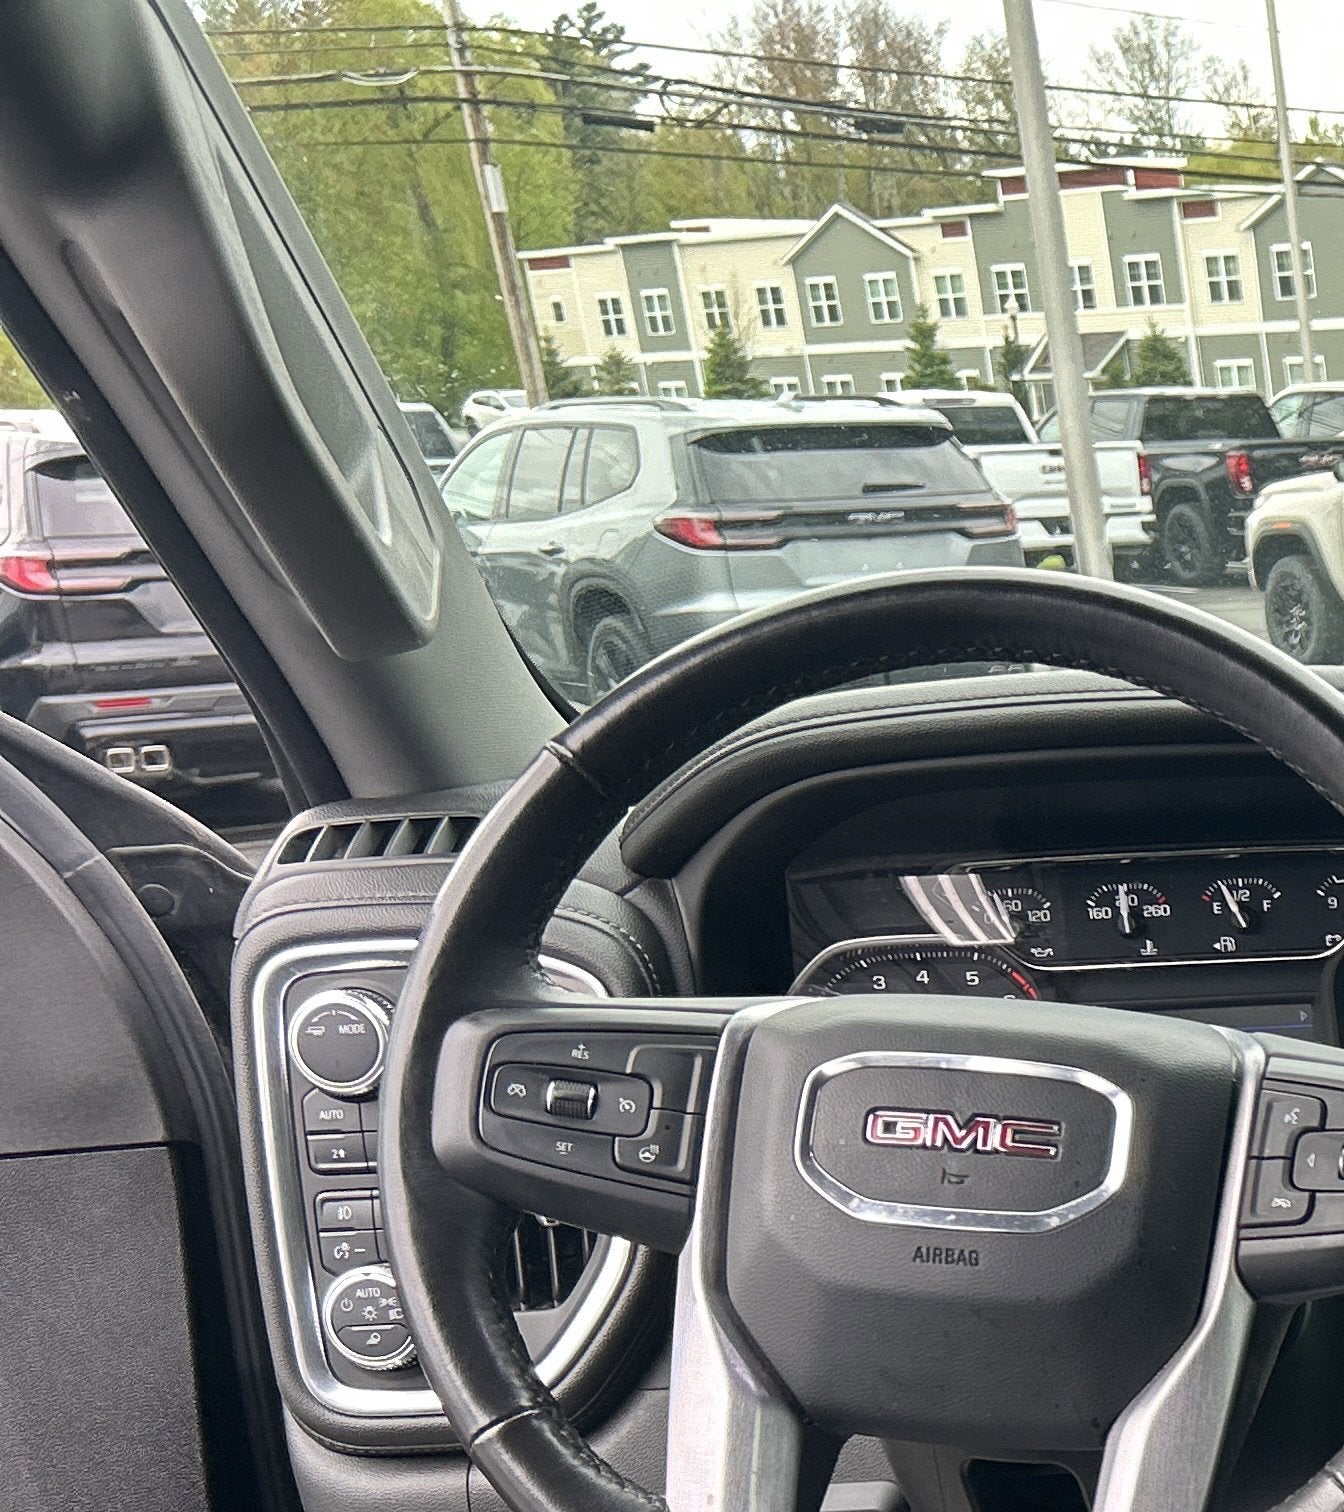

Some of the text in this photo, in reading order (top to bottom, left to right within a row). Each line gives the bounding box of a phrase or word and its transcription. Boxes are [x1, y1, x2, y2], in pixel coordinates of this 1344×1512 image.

[1213, 902, 1222, 914] E
[1263, 899, 1272, 911] F
[1327, 897, 1338, 909] 9
[1027, 910, 1051, 922] 120
[1088, 908, 1112, 920] 160
[1143, 904, 1171, 918] 260
[872, 970, 979, 990] 3 4 5
[338, 1023, 366, 1035] MODE
[571, 1048, 590, 1060] RES
[318, 1110, 344, 1120] AUTO
[864, 1107, 1064, 1161] GMC
[556, 1142, 573, 1152] SET
[912, 1246, 980, 1267] AIRBAG
[355, 1287, 381, 1298] AUTO
